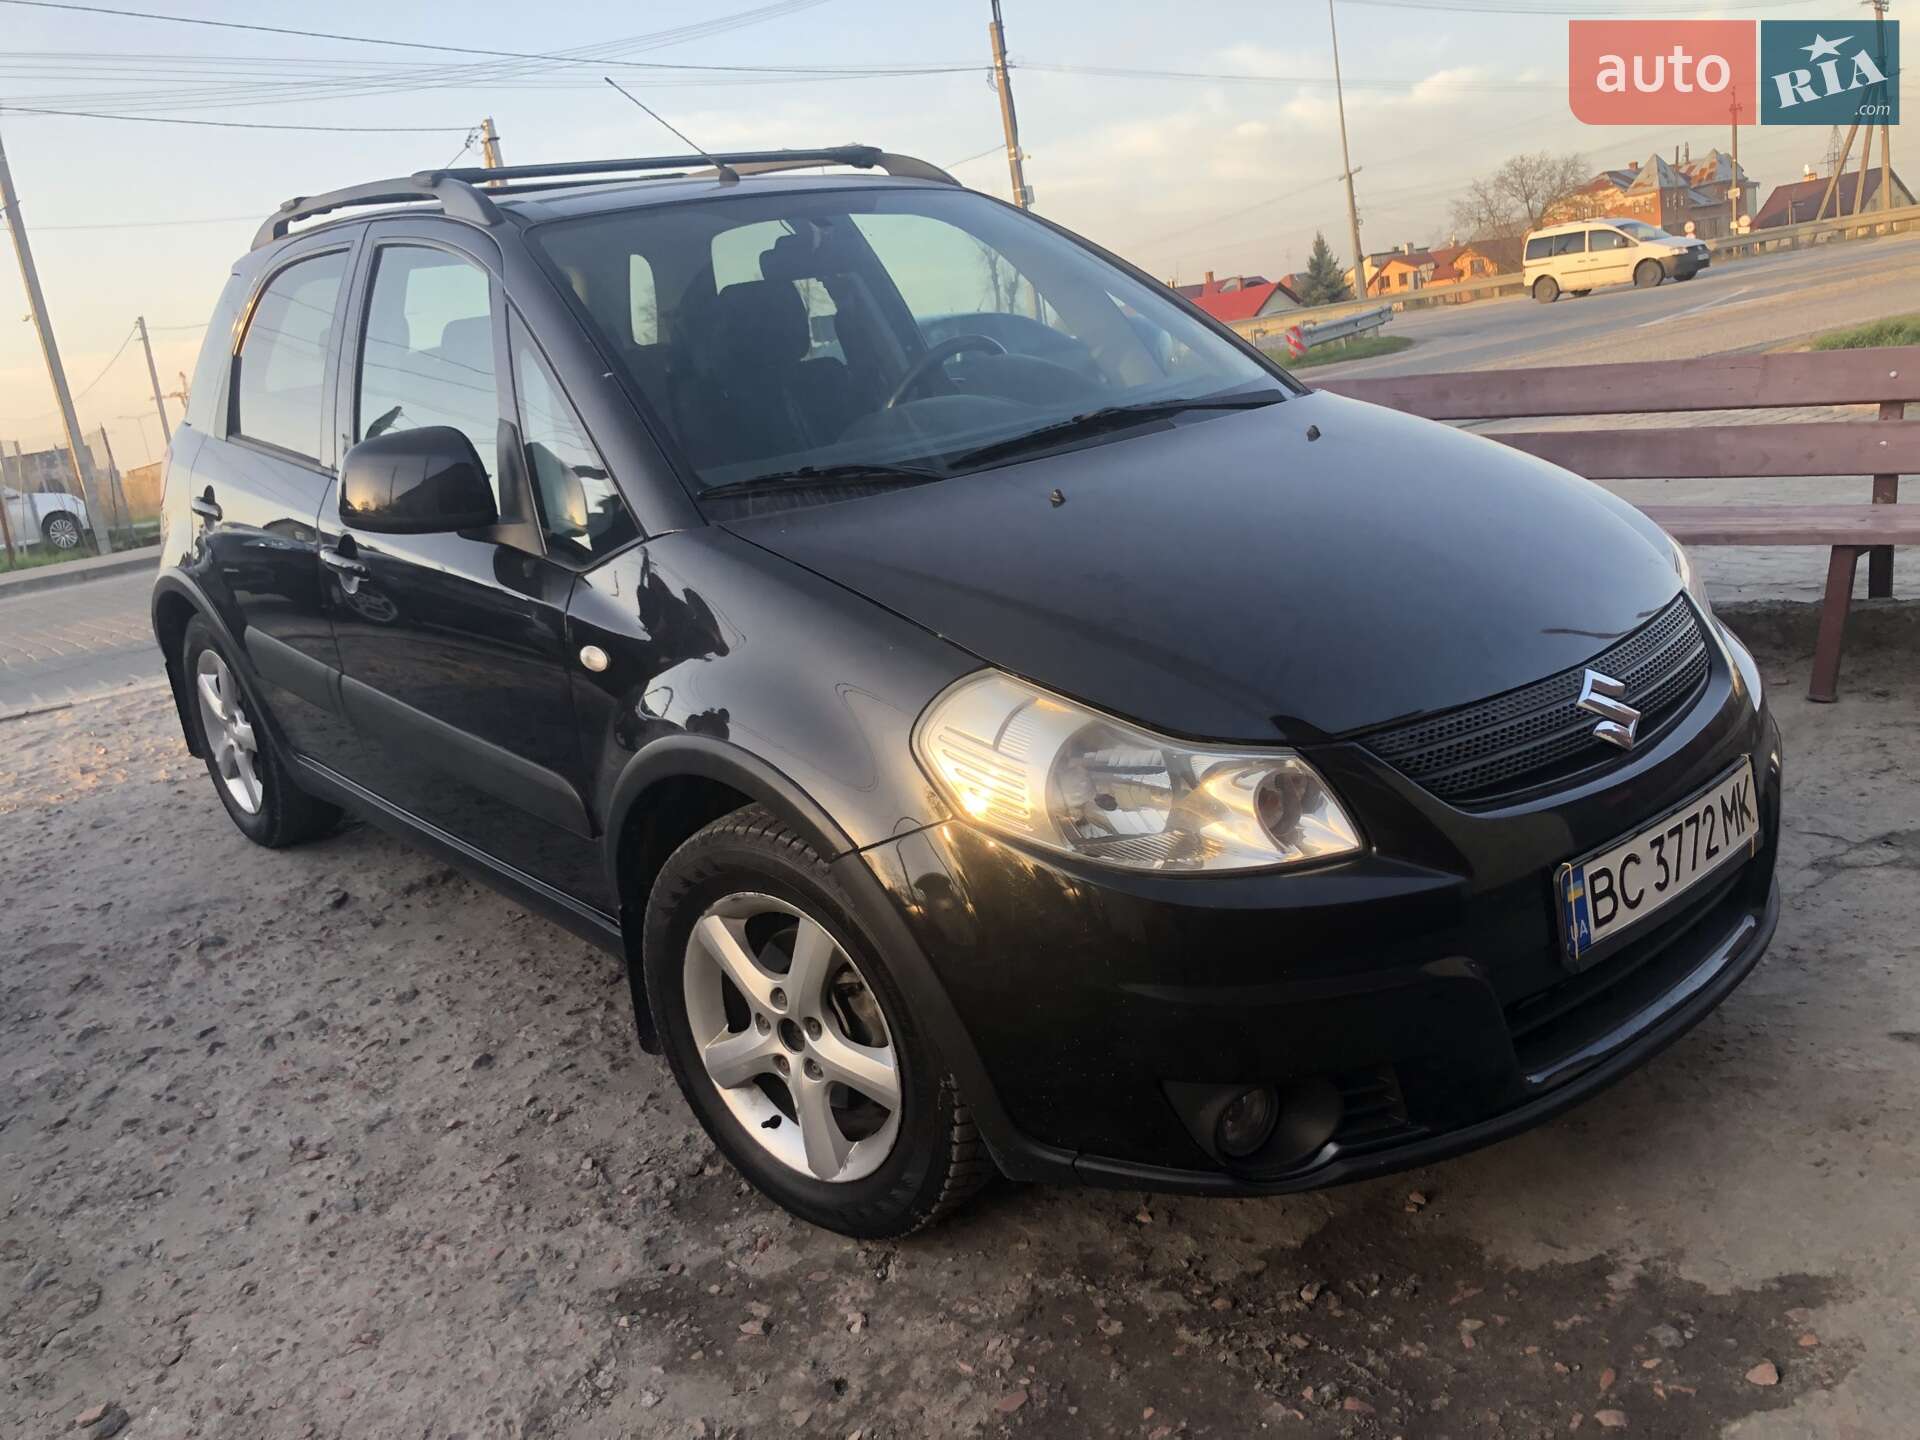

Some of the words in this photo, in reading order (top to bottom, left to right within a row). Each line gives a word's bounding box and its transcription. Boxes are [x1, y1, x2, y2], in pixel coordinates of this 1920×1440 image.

[1588, 852, 1645, 929] BC
[1649, 804, 1720, 892] 3772
[1720, 773, 1756, 847] MK
